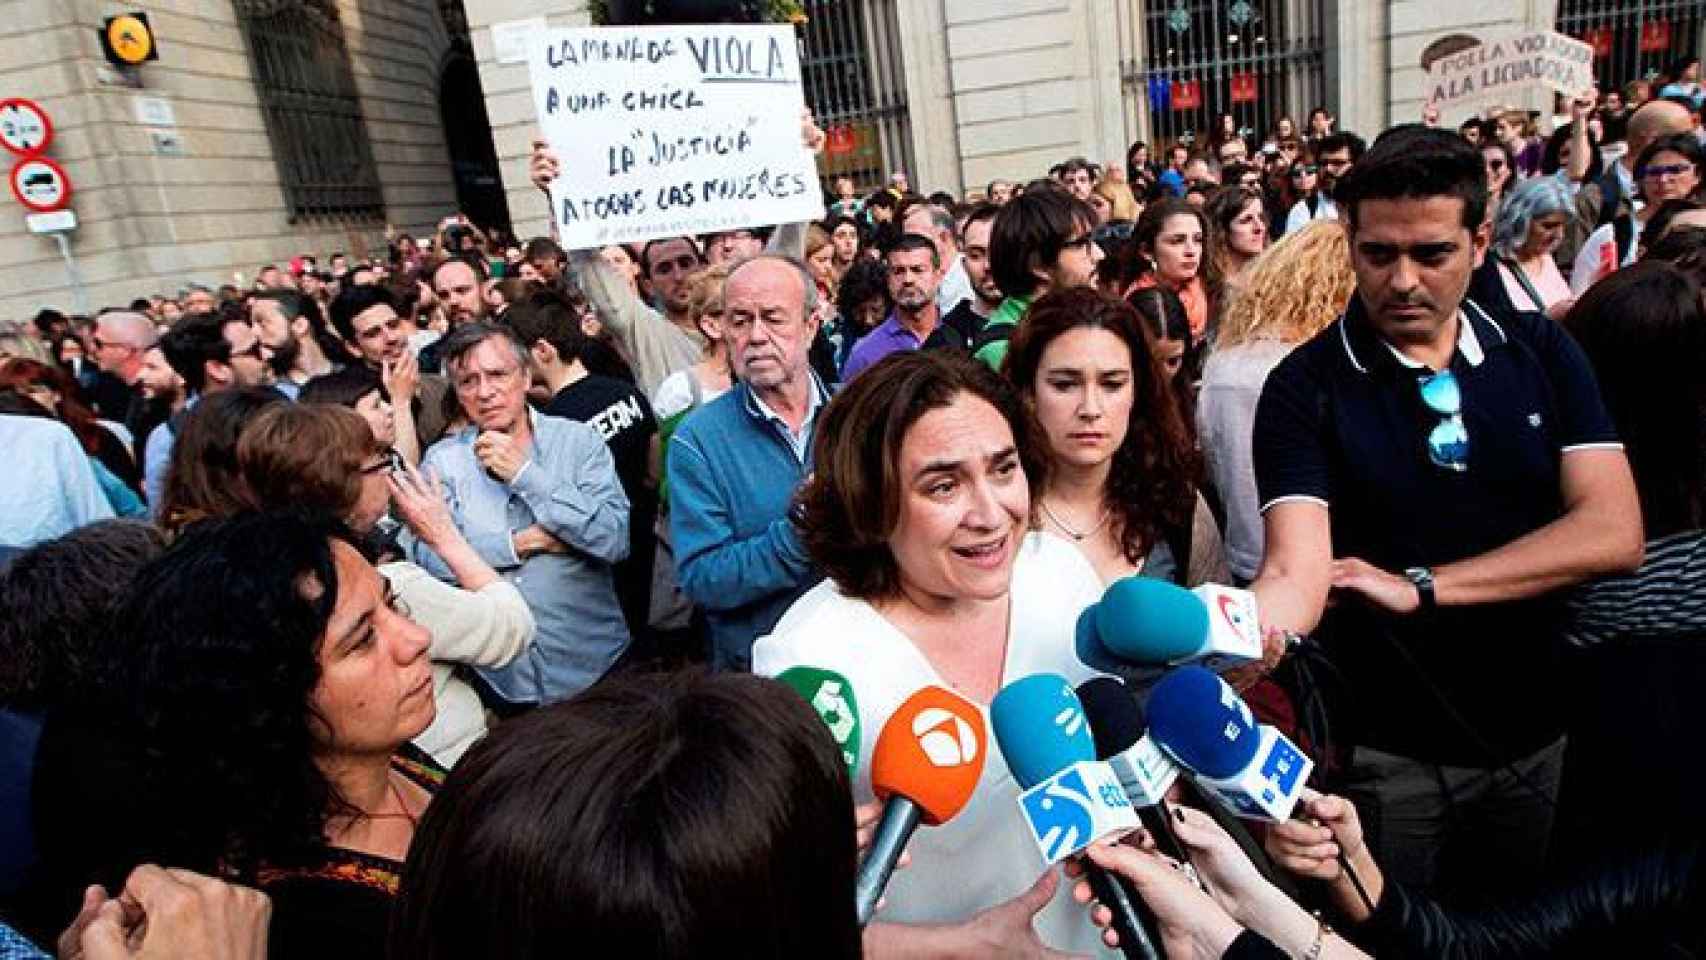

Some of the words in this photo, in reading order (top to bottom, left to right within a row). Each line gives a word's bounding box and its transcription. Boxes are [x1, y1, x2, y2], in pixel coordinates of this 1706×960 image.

[546, 39, 578, 68] LA
[685, 35, 785, 78] VIOLA
[546, 86, 560, 114] A
[608, 145, 636, 176] LA
[657, 180, 695, 211] LAS
[702, 168, 806, 202] MUJERES
